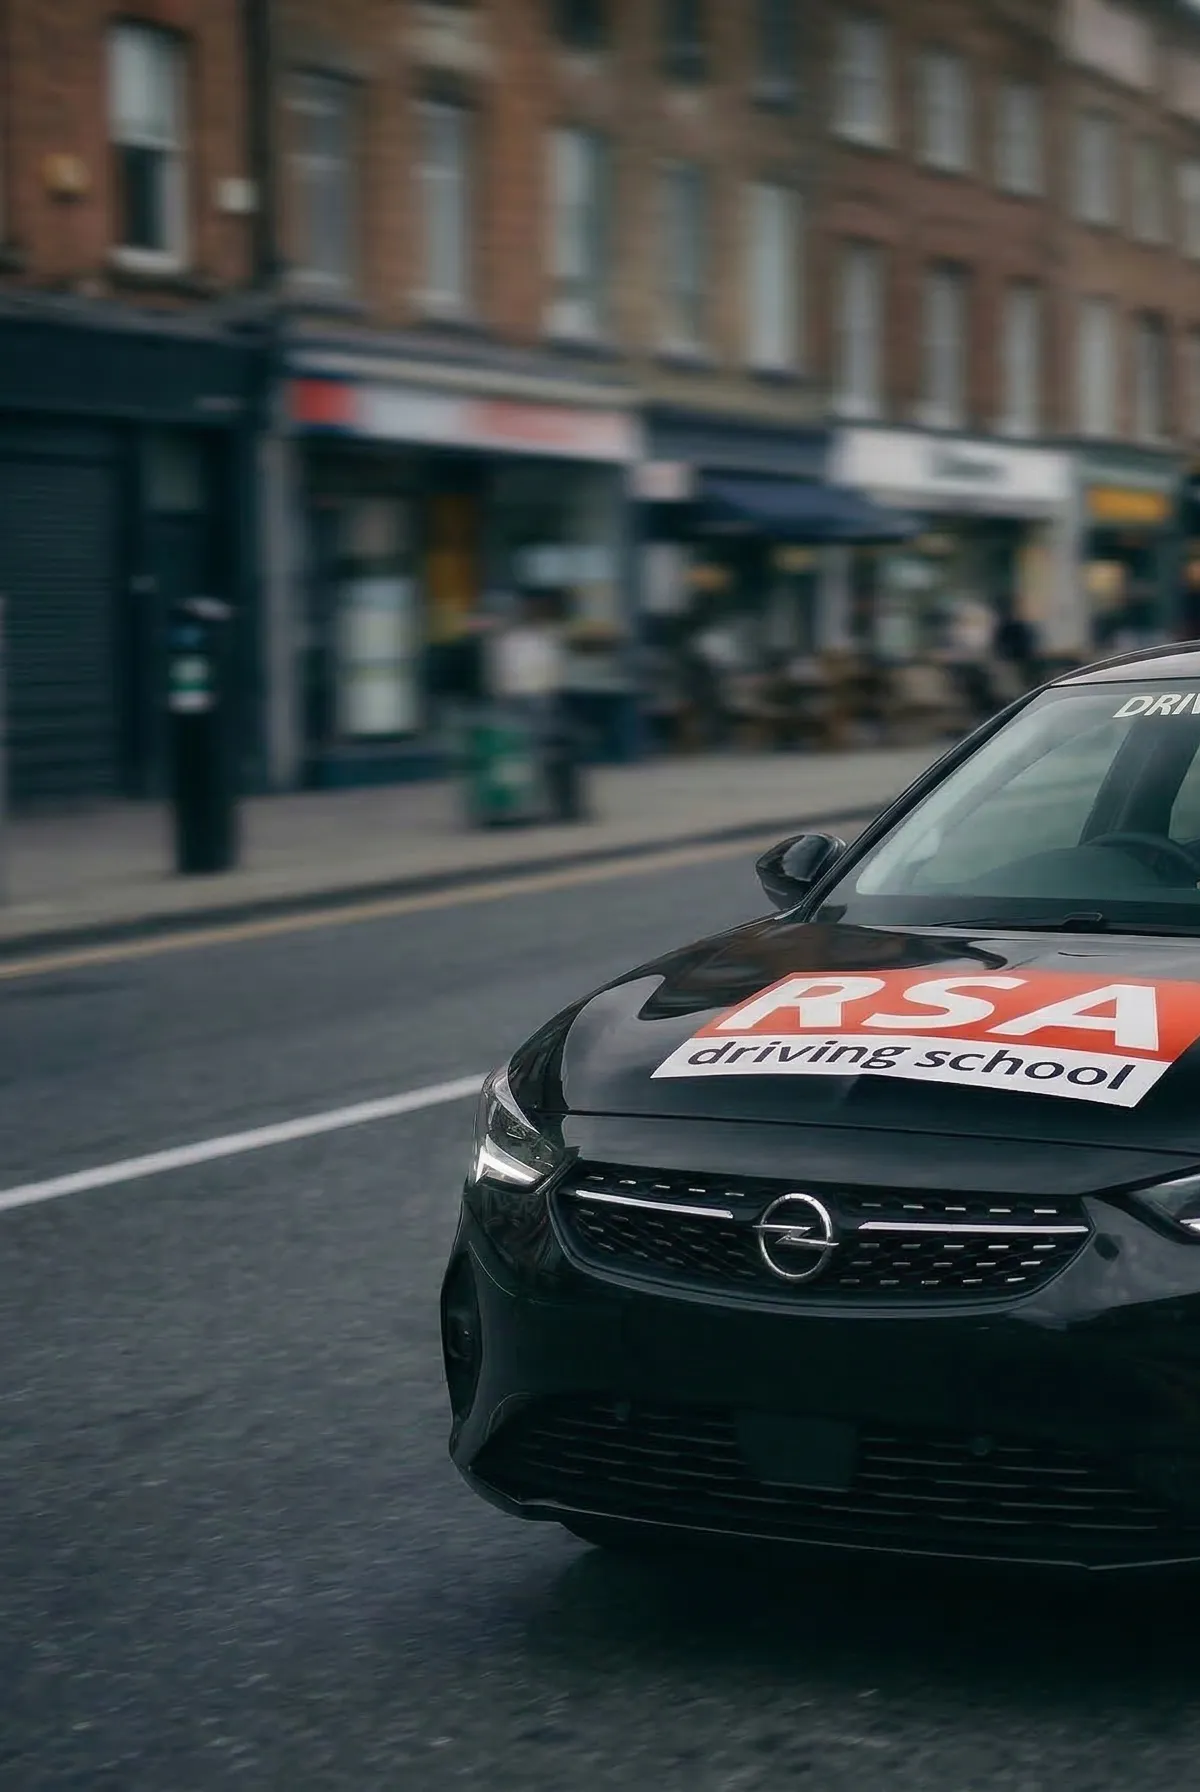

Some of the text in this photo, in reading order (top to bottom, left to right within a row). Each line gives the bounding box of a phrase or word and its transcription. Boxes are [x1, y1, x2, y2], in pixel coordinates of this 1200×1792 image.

[715, 976, 1161, 1052] RSA
[688, 1040, 1136, 1090] driving school
